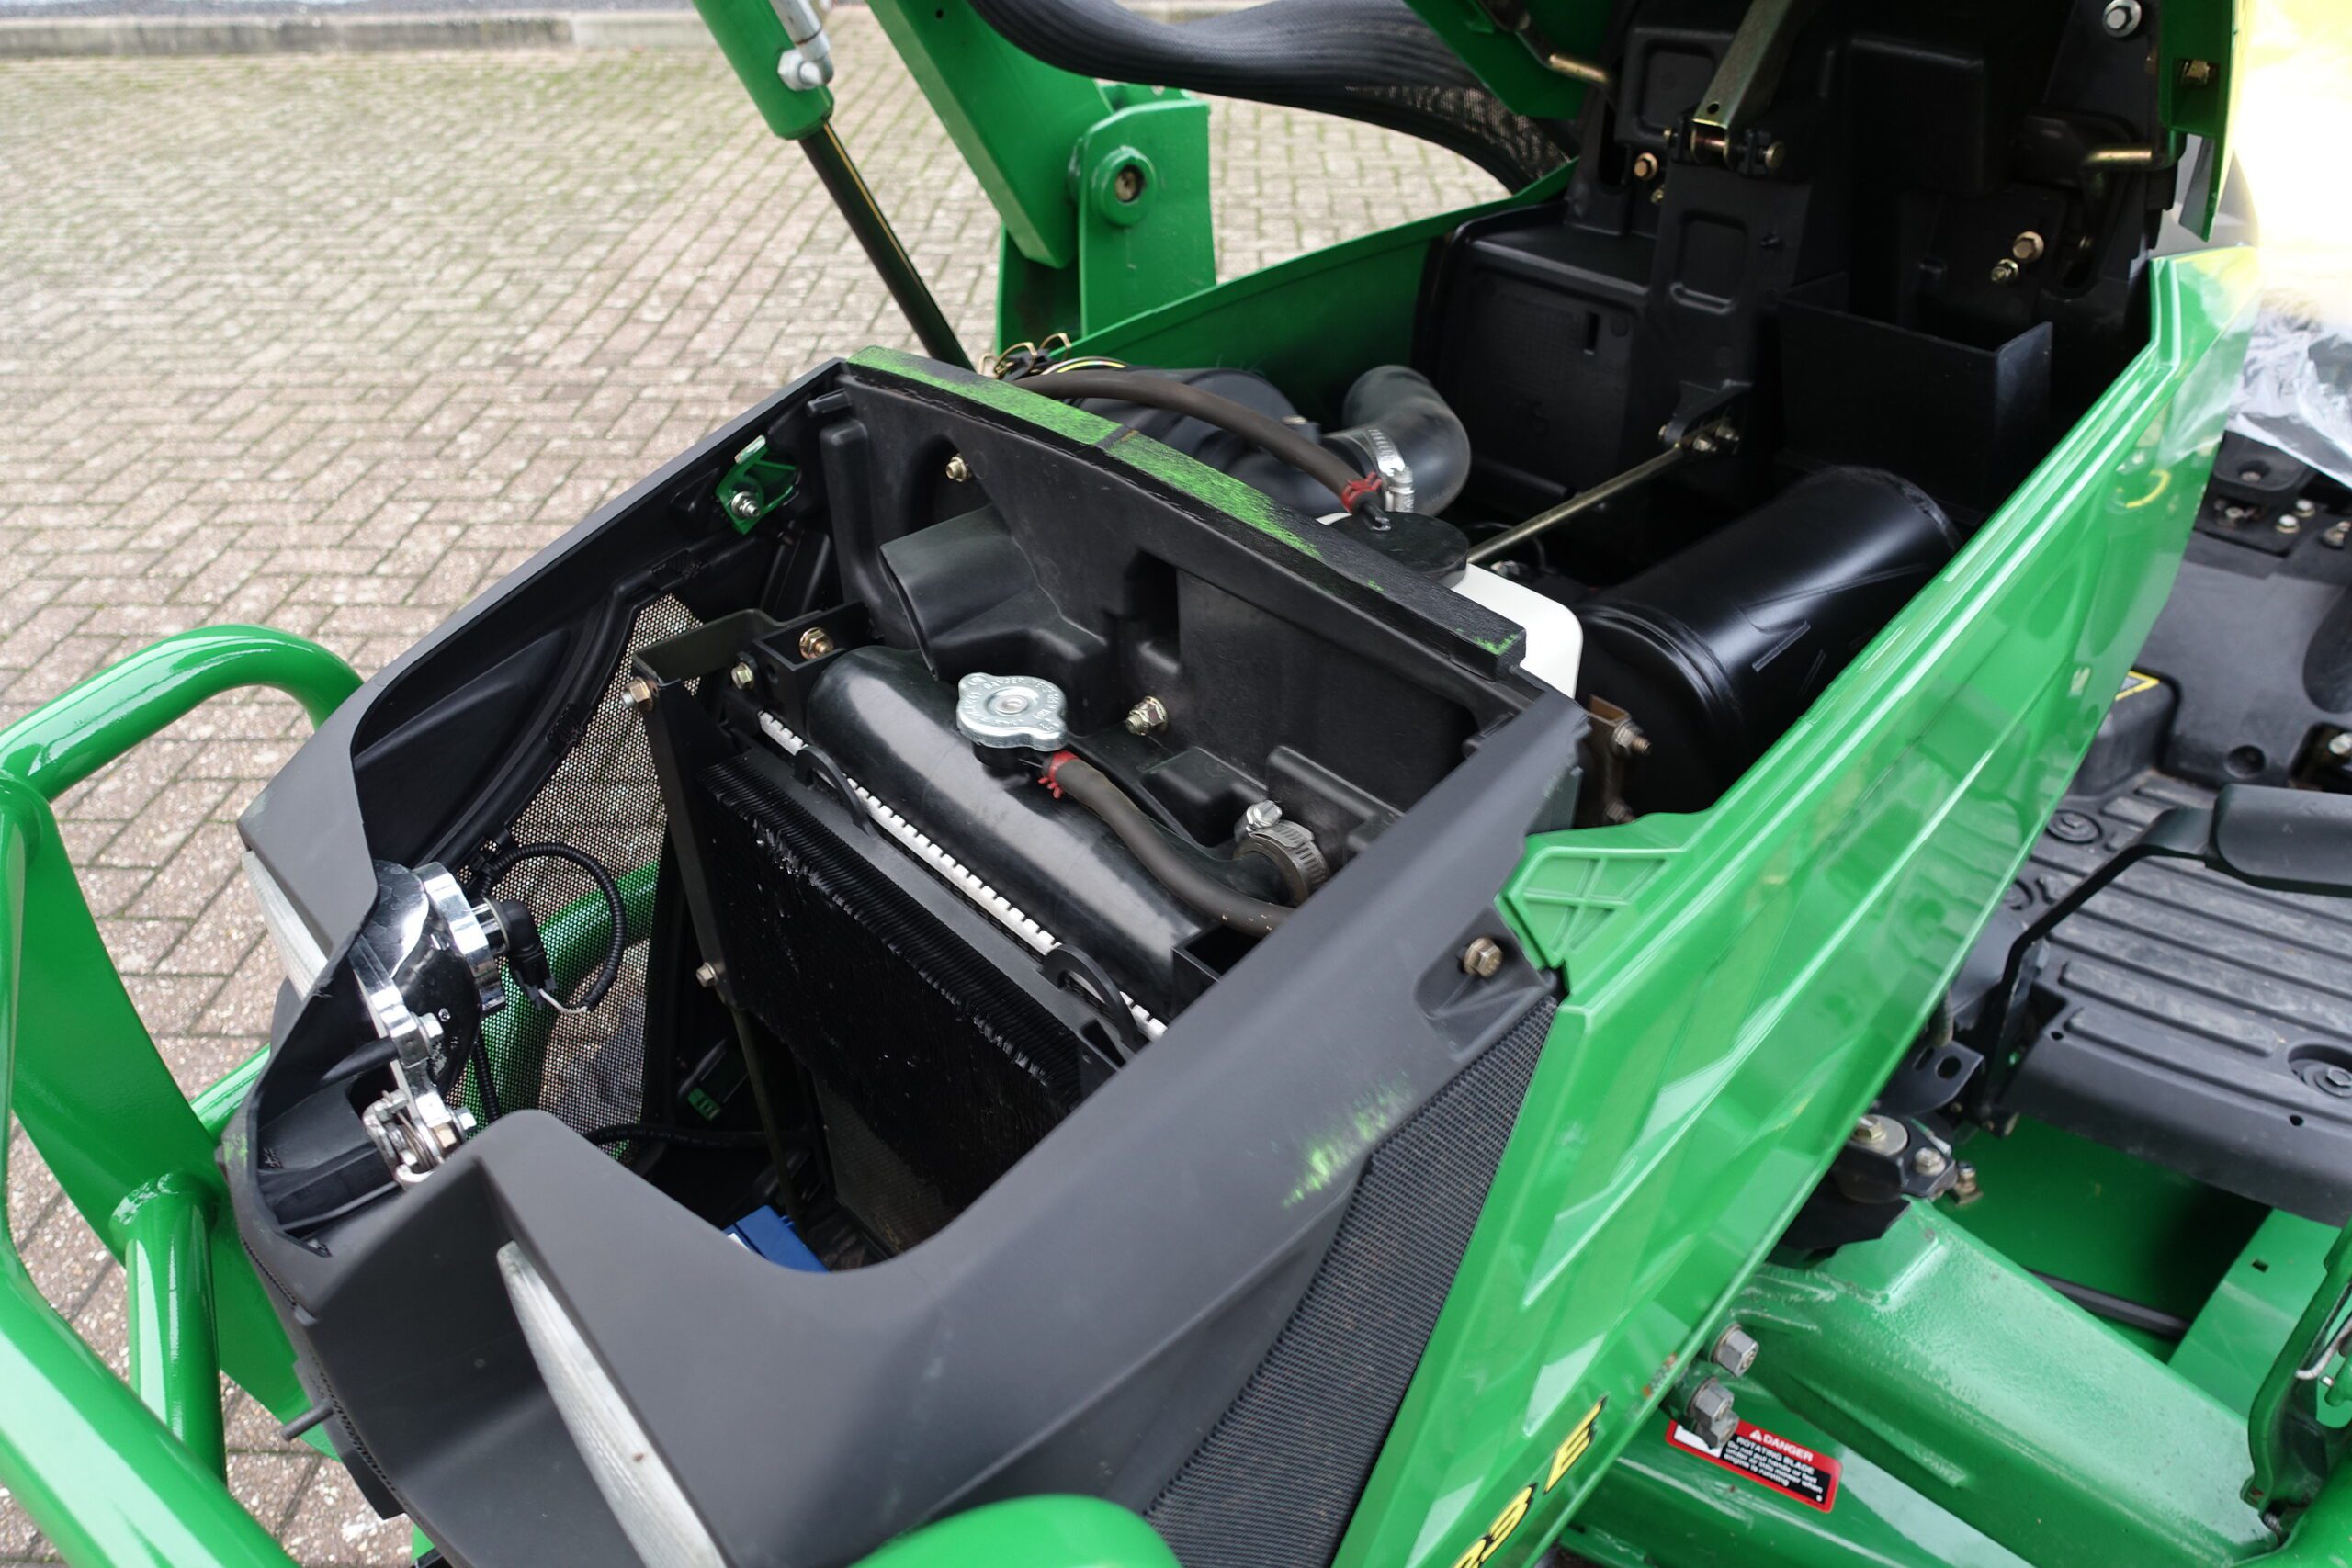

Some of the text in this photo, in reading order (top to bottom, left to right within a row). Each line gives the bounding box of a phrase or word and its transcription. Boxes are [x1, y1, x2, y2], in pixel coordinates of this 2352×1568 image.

[1736, 1437, 1815, 1475] ROTATING BLADE
[1740, 1446, 1754, 1456] not
[1763, 1434, 1814, 1462] DANGER
